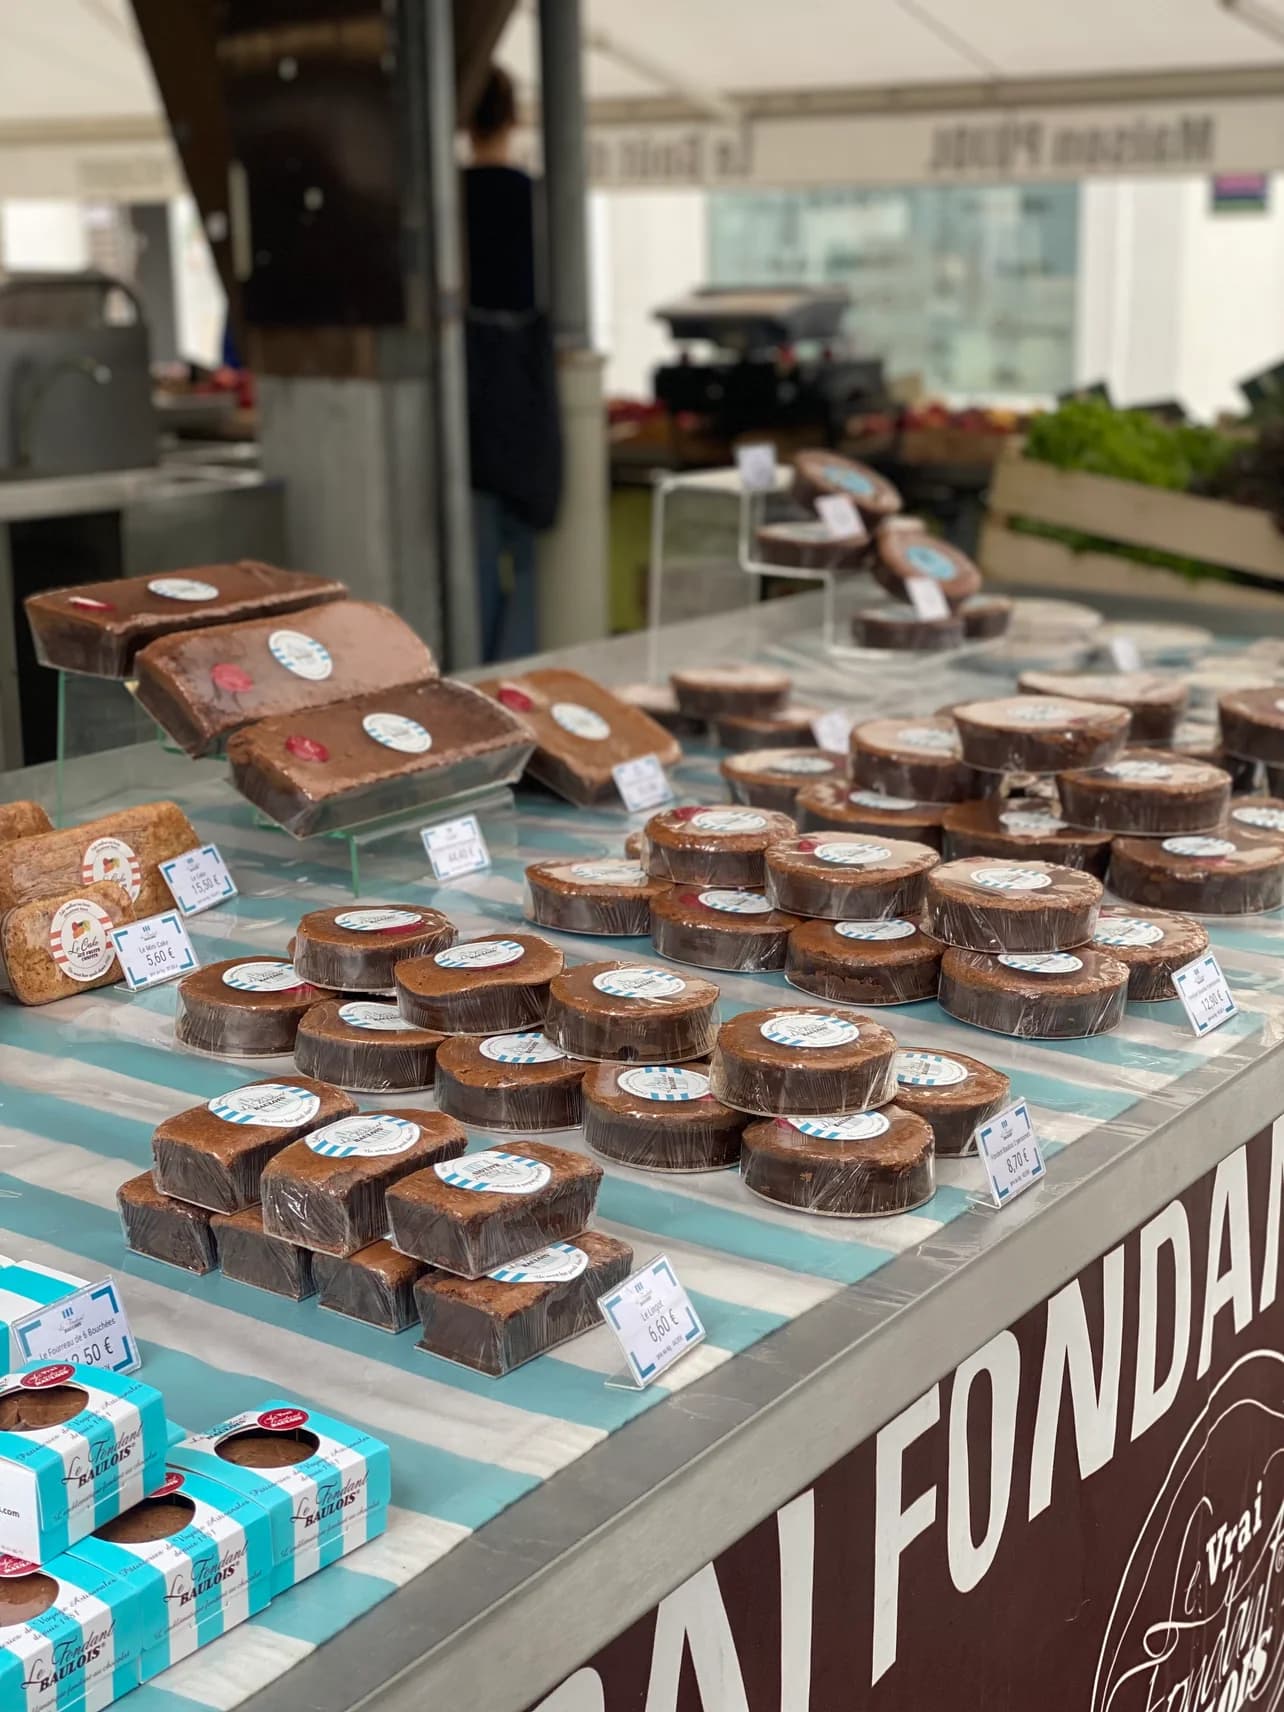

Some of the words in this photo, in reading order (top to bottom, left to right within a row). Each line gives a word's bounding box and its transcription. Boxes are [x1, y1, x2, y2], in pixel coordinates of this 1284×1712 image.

[191, 878, 214, 895] 15,50
[213, 874, 221, 886] €
[146, 950, 167, 967] 5,60
[168, 947, 175, 959] €
[1006, 1151, 1023, 1174] 8,70
[1023, 1147, 1029, 1162] €
[39, 1350, 48, 1360] Le
[47, 1339, 75, 1356] Fourreau
[75, 1333, 83, 1344] de
[87, 1317, 116, 1338] Bouchées
[104, 1336, 114, 1354] €
[648, 1314, 670, 1343] 6,60
[669, 1308, 679, 1326] €
[62, 1456, 82, 1485] Le
[88, 1422, 144, 1463] Fondant
[289, 1497, 310, 1525] Le
[316, 1472, 369, 1506] Fondant
[1205, 1480, 1263, 1586] Vrai
[163, 1574, 184, 1603] Le
[192, 1540, 248, 1581] Fondant
[20, 1658, 46, 1690] Le
[51, 1619, 116, 1666] Fondant
